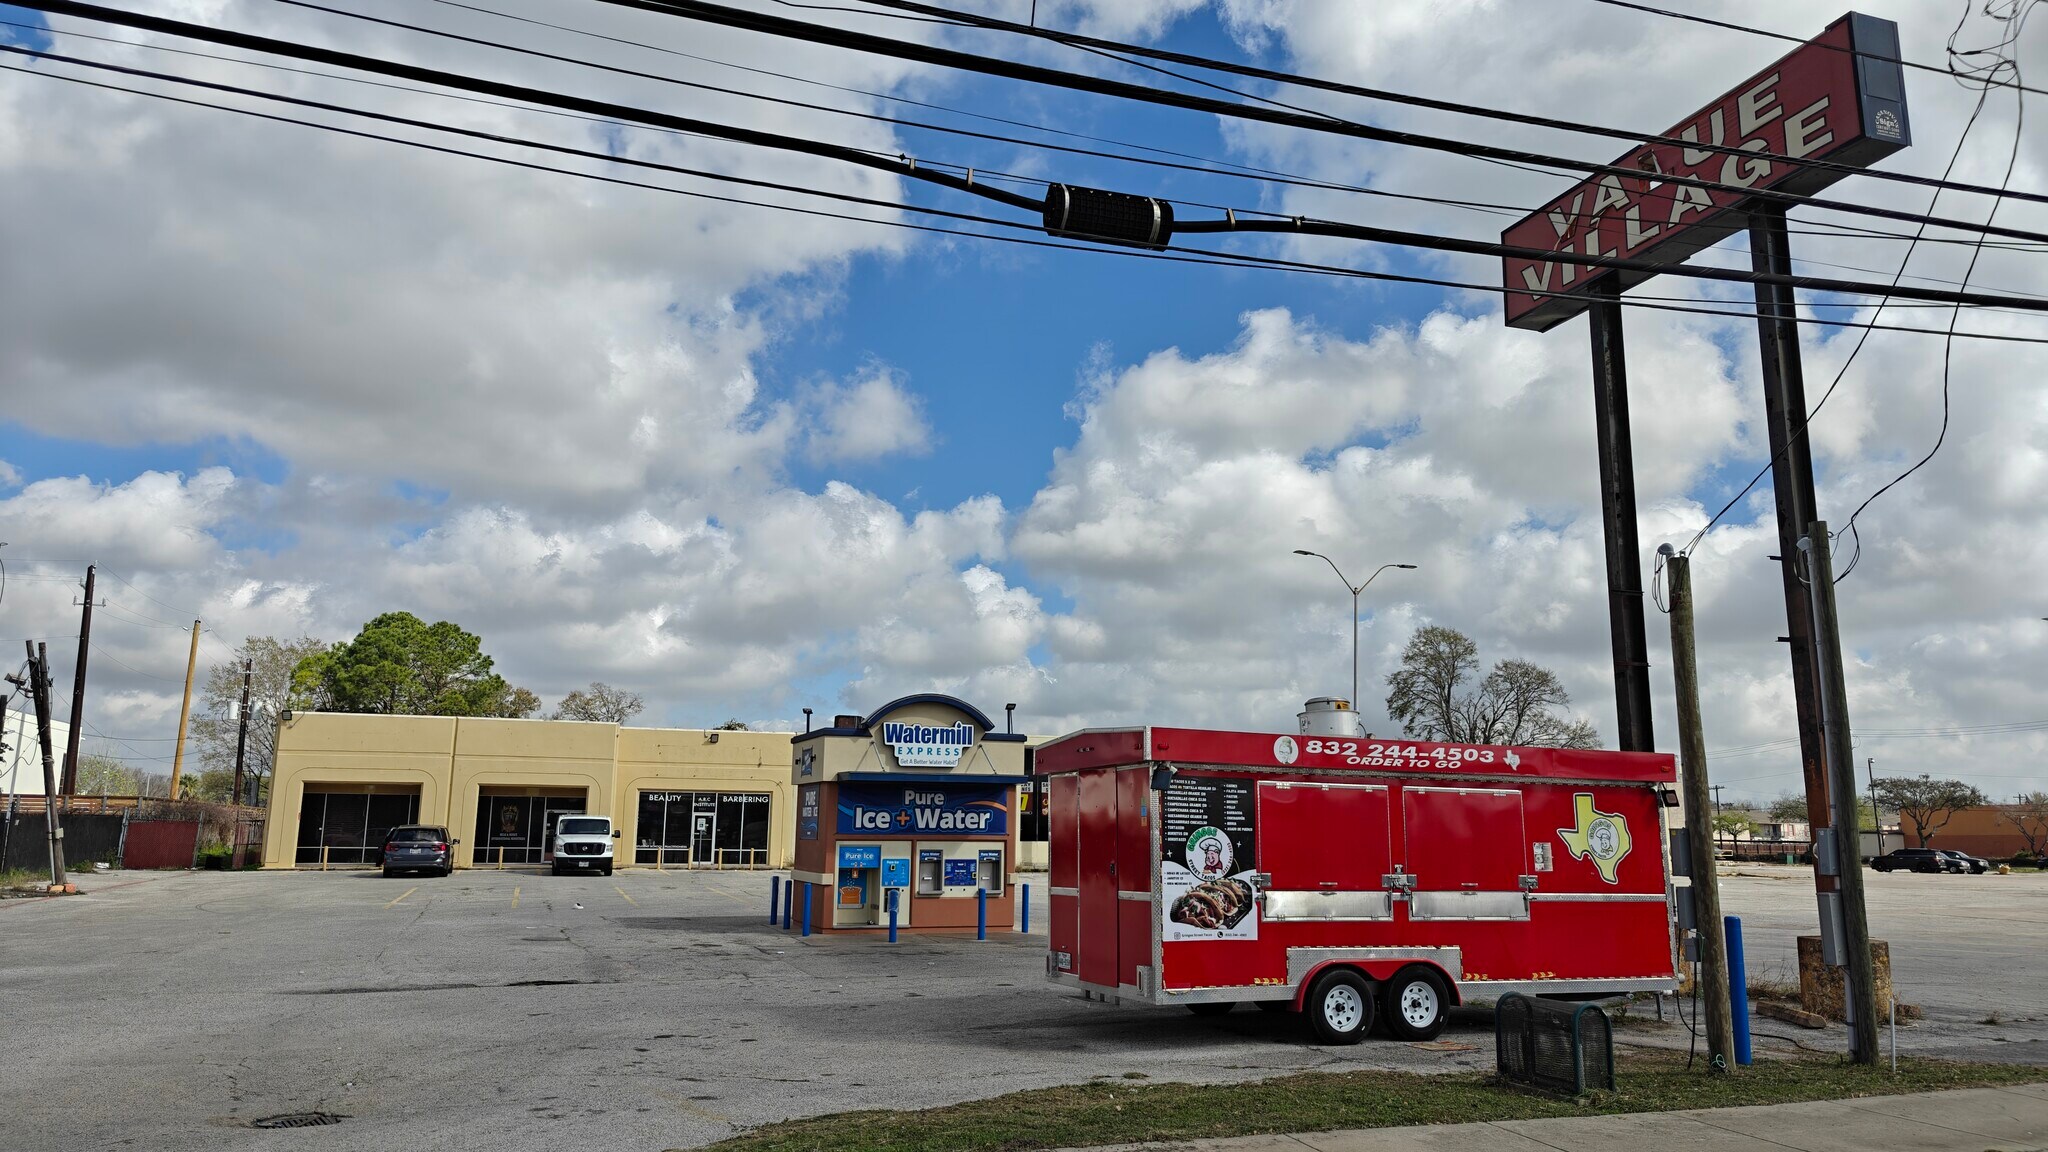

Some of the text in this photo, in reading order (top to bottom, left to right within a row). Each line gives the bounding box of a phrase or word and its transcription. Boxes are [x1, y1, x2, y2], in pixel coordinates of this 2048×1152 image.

[1521, 95, 1834, 302] VILLAGE
[885, 720, 973, 745] Watermill
[898, 746, 960, 756] EXPRESS
[1305, 740, 1494, 763] 832 244-4503
[1346, 756, 1461, 769] ORDER TO GO
[649, 794, 682, 802] BEAUTY
[723, 795, 769, 803] BARBERING
[805, 791, 816, 806] PURE
[904, 790, 945, 805] Pure
[855, 807, 891, 829] Ice
[914, 807, 991, 830] Water
[1186, 826, 1218, 852] GRINGOS
[845, 852, 874, 860] Pure Ice
[1188, 858, 1201, 876] STREET
